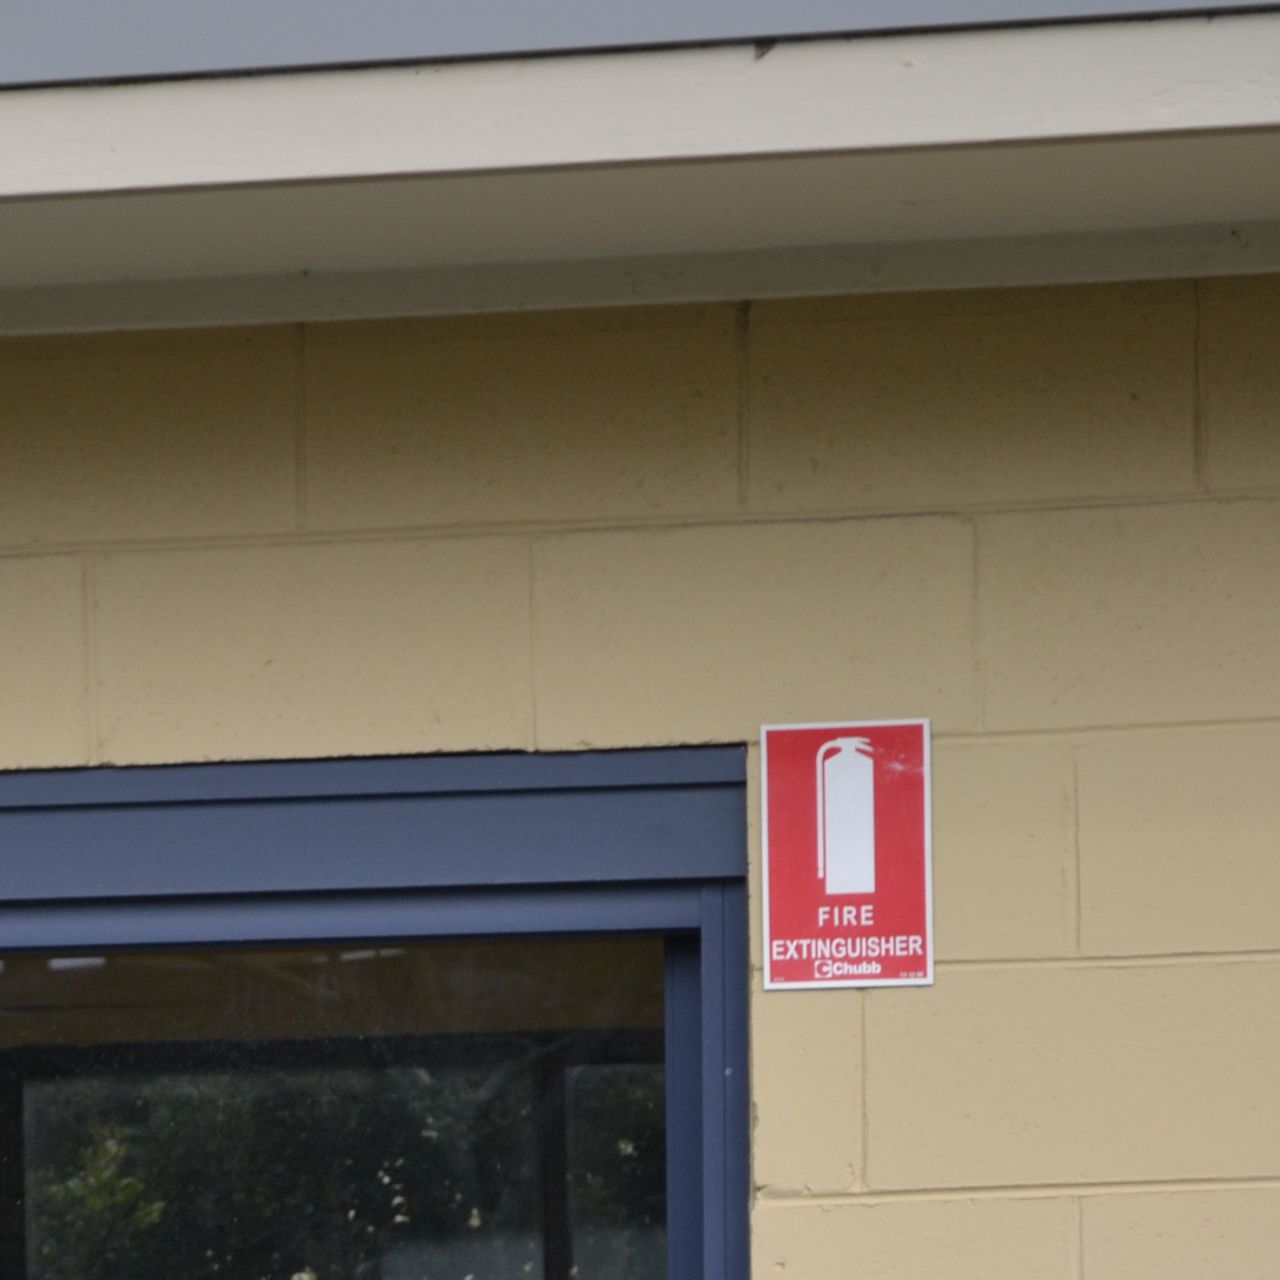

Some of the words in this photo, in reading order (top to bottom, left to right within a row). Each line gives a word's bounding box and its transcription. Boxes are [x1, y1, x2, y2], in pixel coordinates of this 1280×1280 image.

[818, 904, 875, 927] FIRE
[771, 934, 923, 961] EXTINGUISHER
[832, 959, 882, 976] Chubb
